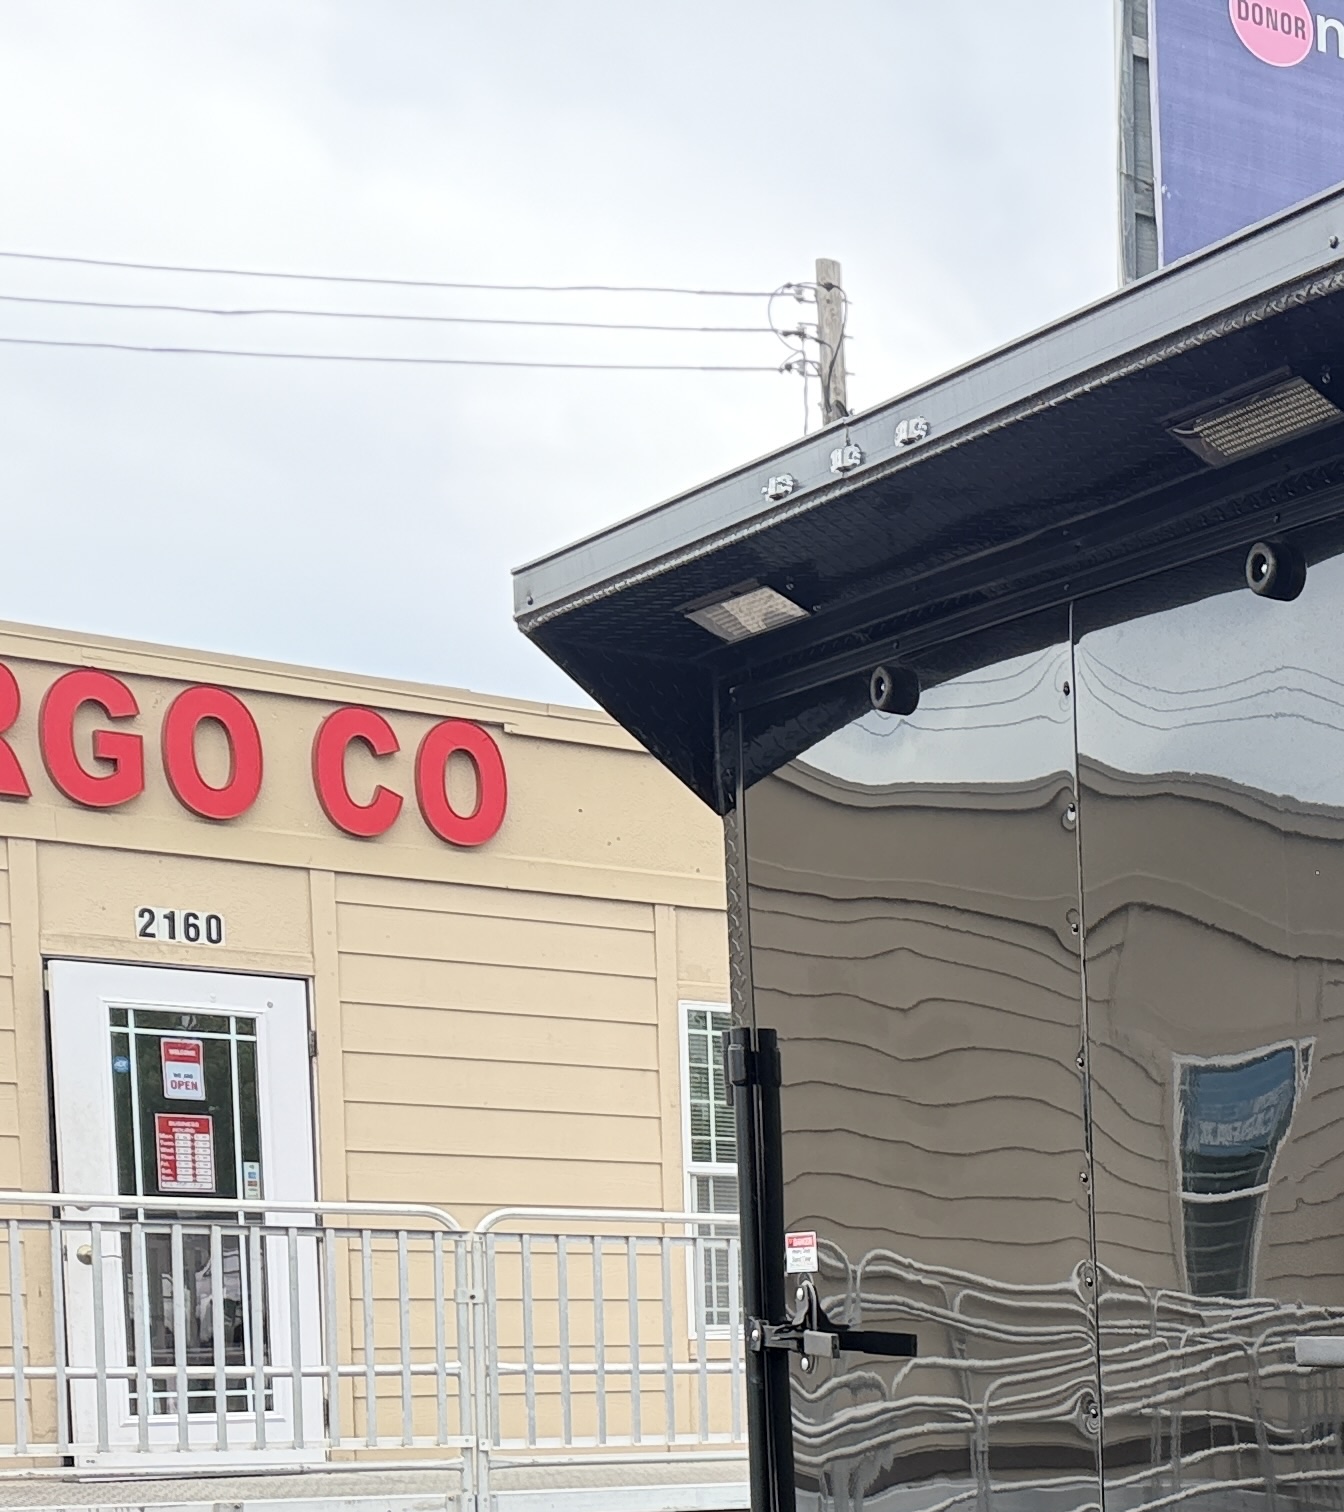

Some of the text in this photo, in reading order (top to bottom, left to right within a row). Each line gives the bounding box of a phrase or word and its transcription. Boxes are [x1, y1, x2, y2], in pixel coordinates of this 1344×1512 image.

[1237, 0, 1306, 40] DONOR
[312, 706, 507, 846] CO
[138, 908, 222, 944] 2160
[170, 1079, 198, 1091] OPEN
